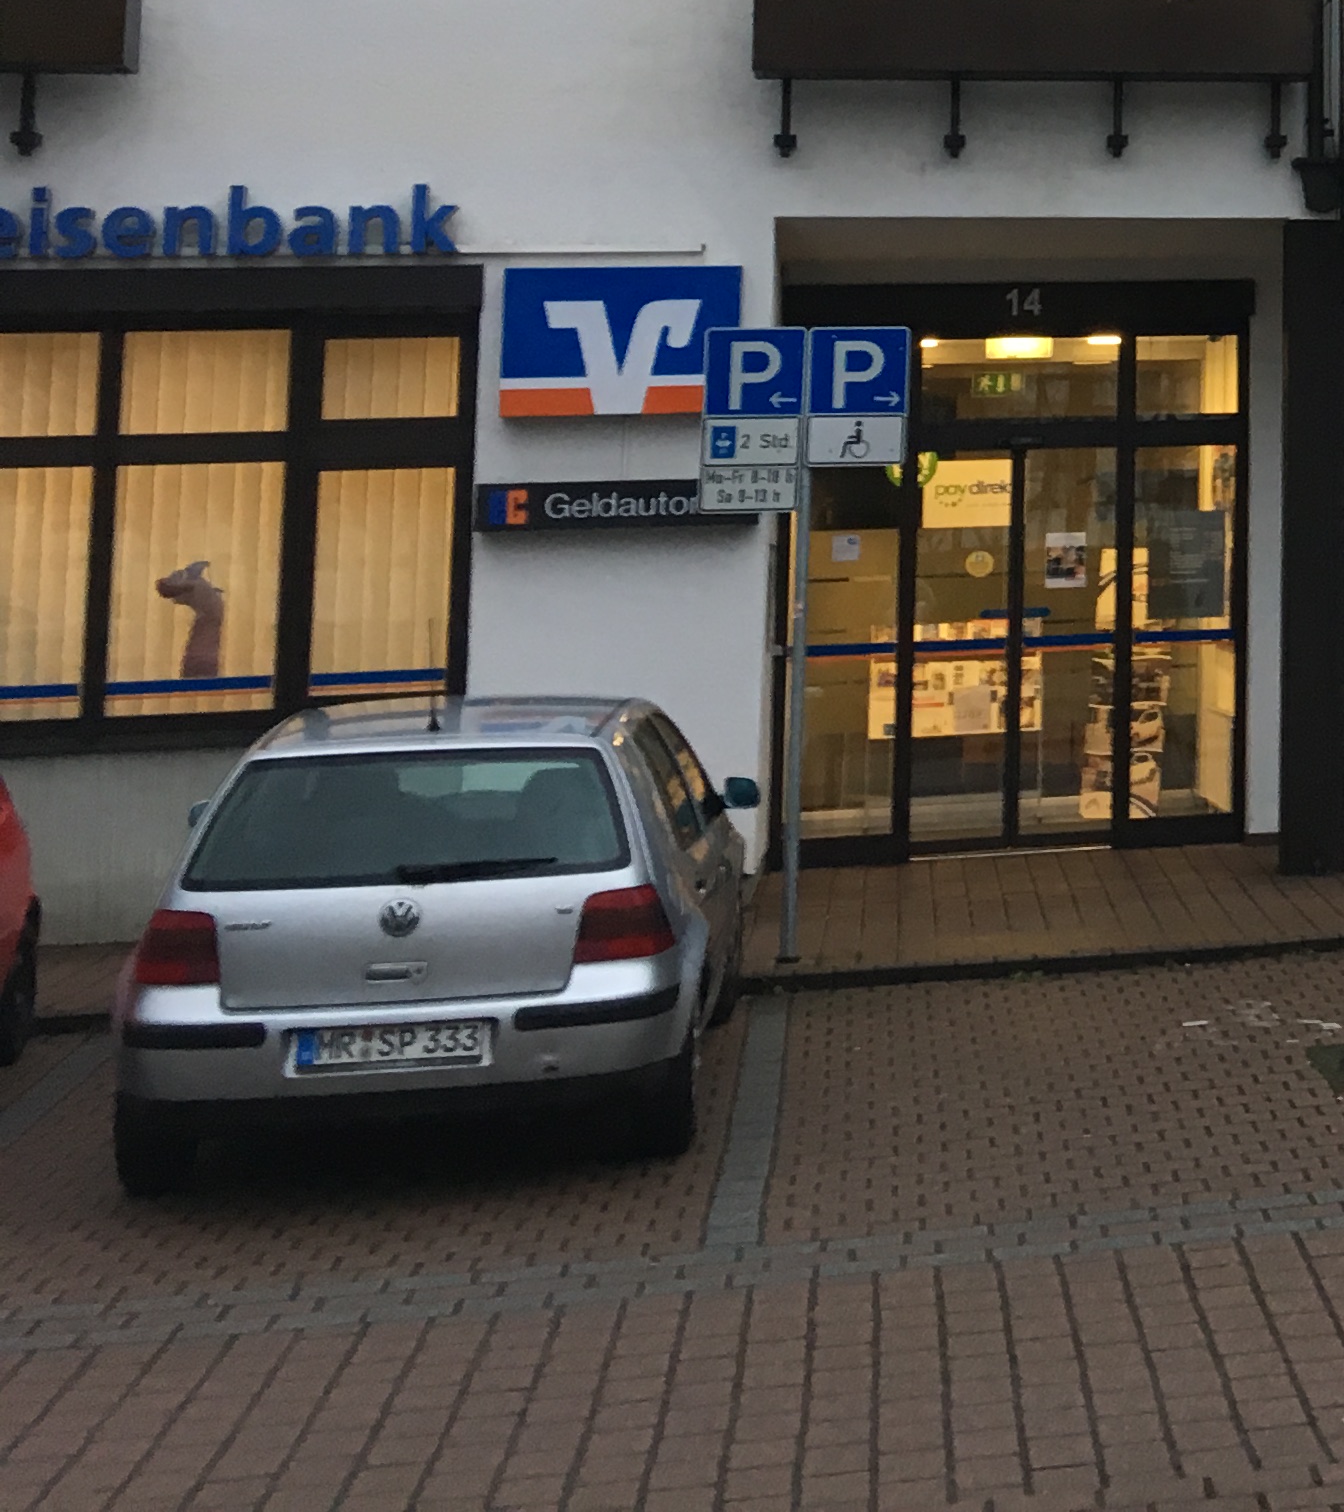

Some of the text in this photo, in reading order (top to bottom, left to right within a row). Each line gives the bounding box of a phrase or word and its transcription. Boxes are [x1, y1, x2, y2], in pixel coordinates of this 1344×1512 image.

[1005, 288, 1043, 317] 14
[728, 340, 783, 410] P
[832, 340, 886, 409] P
[740, 434, 750, 449] 2
[544, 491, 701, 519] Geldauto
[422, 1024, 479, 1055] 333
